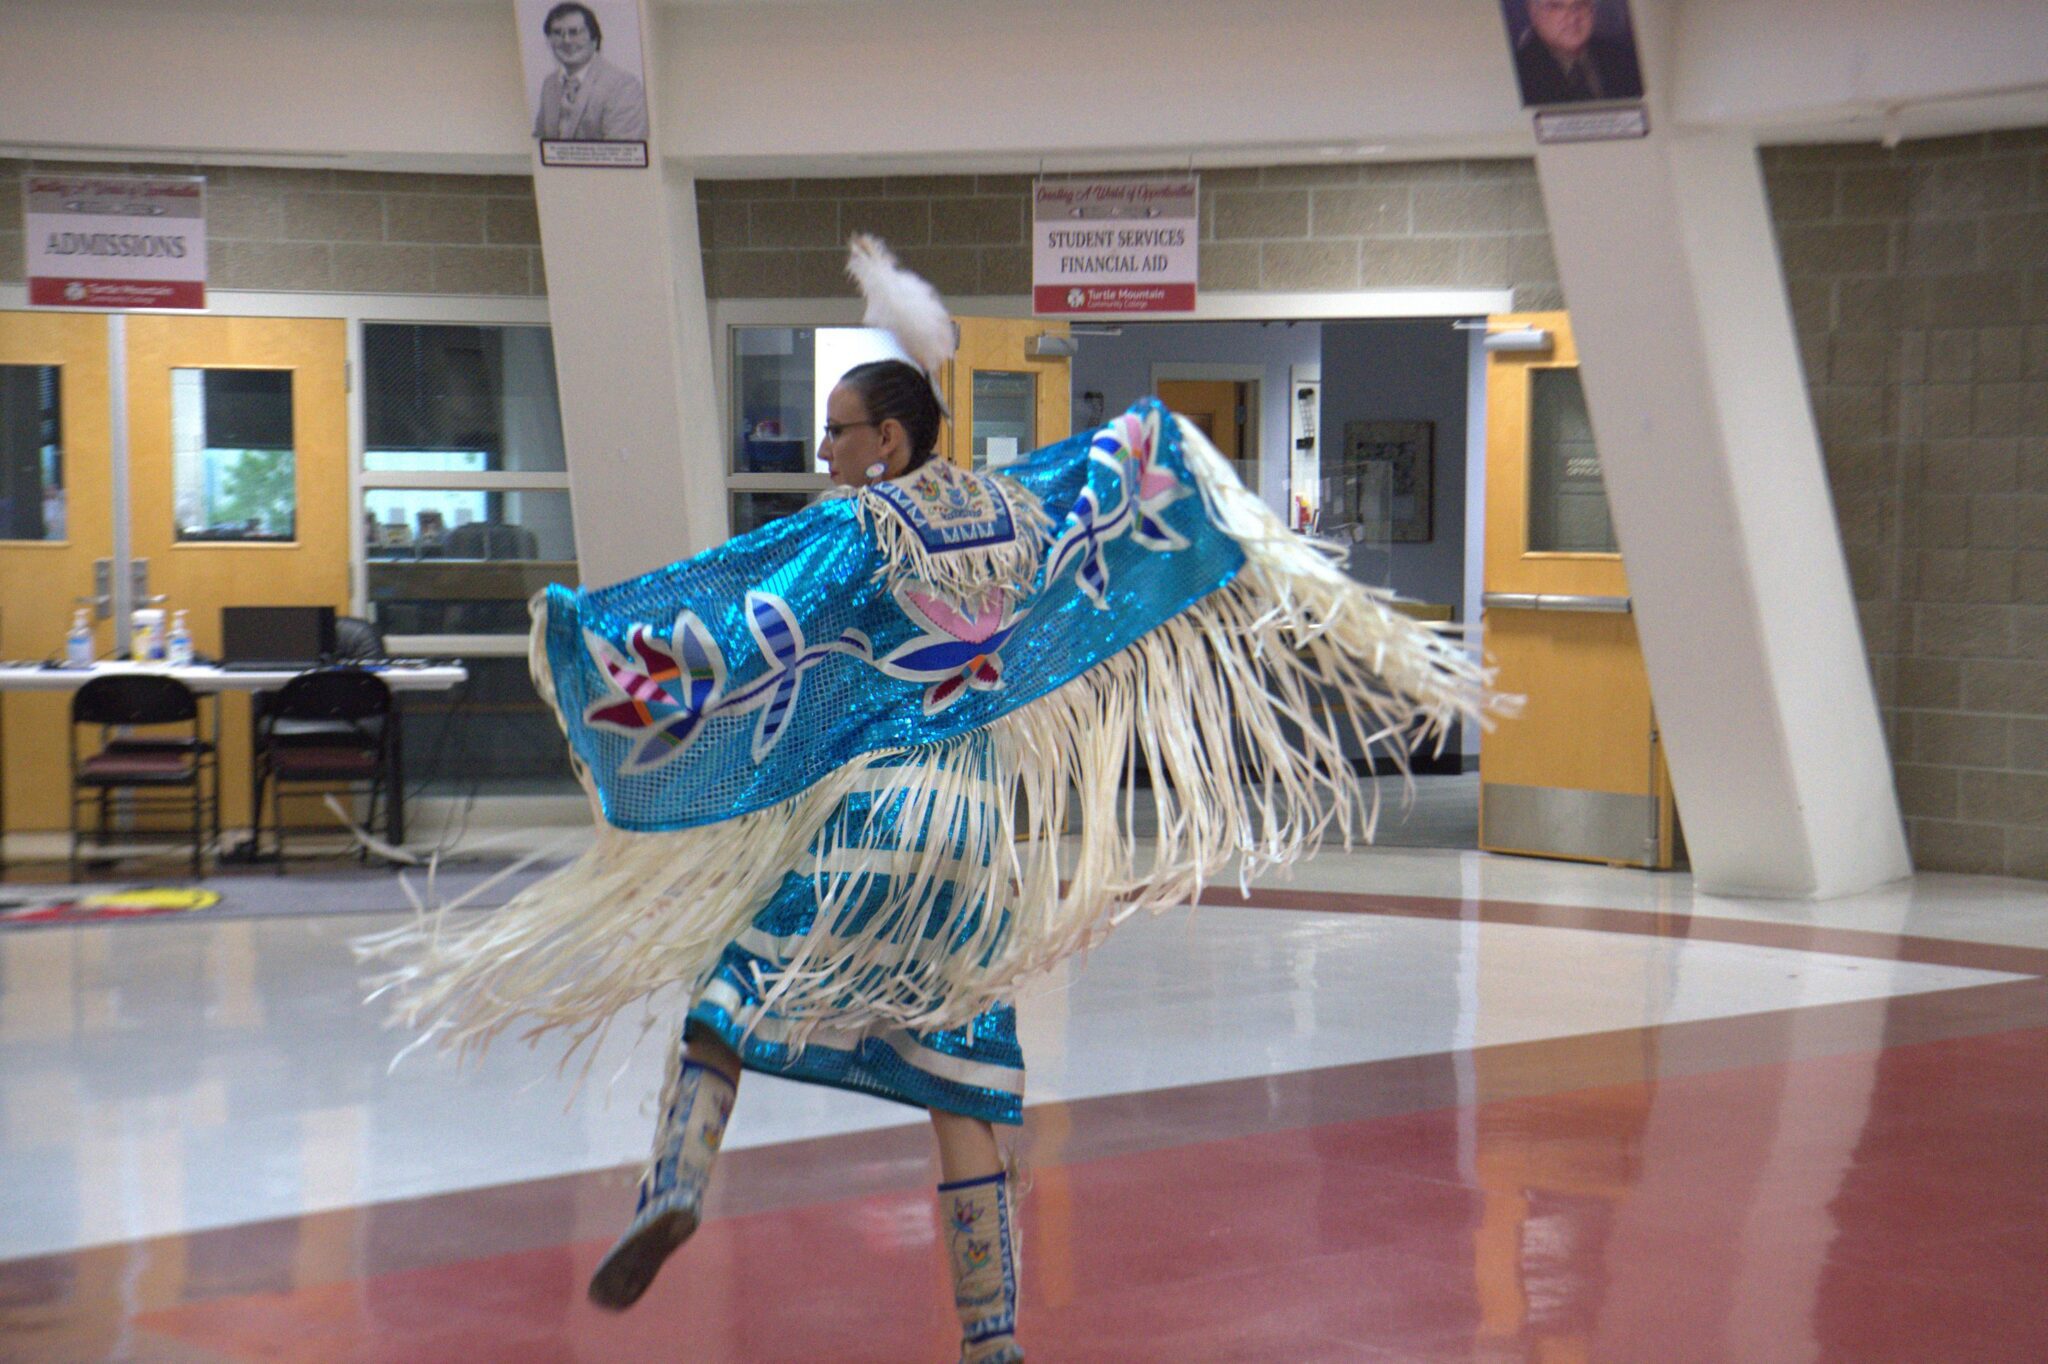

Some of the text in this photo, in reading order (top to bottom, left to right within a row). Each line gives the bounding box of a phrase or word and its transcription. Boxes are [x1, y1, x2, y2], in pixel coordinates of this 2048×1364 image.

[45, 232, 187, 258] ADMISSIONS
[1049, 228, 1185, 248] STUDENT SERVICES
[1061, 253, 1168, 273] FINANCIAL AID
[1088, 288, 1165, 300] Turtle Mountain
